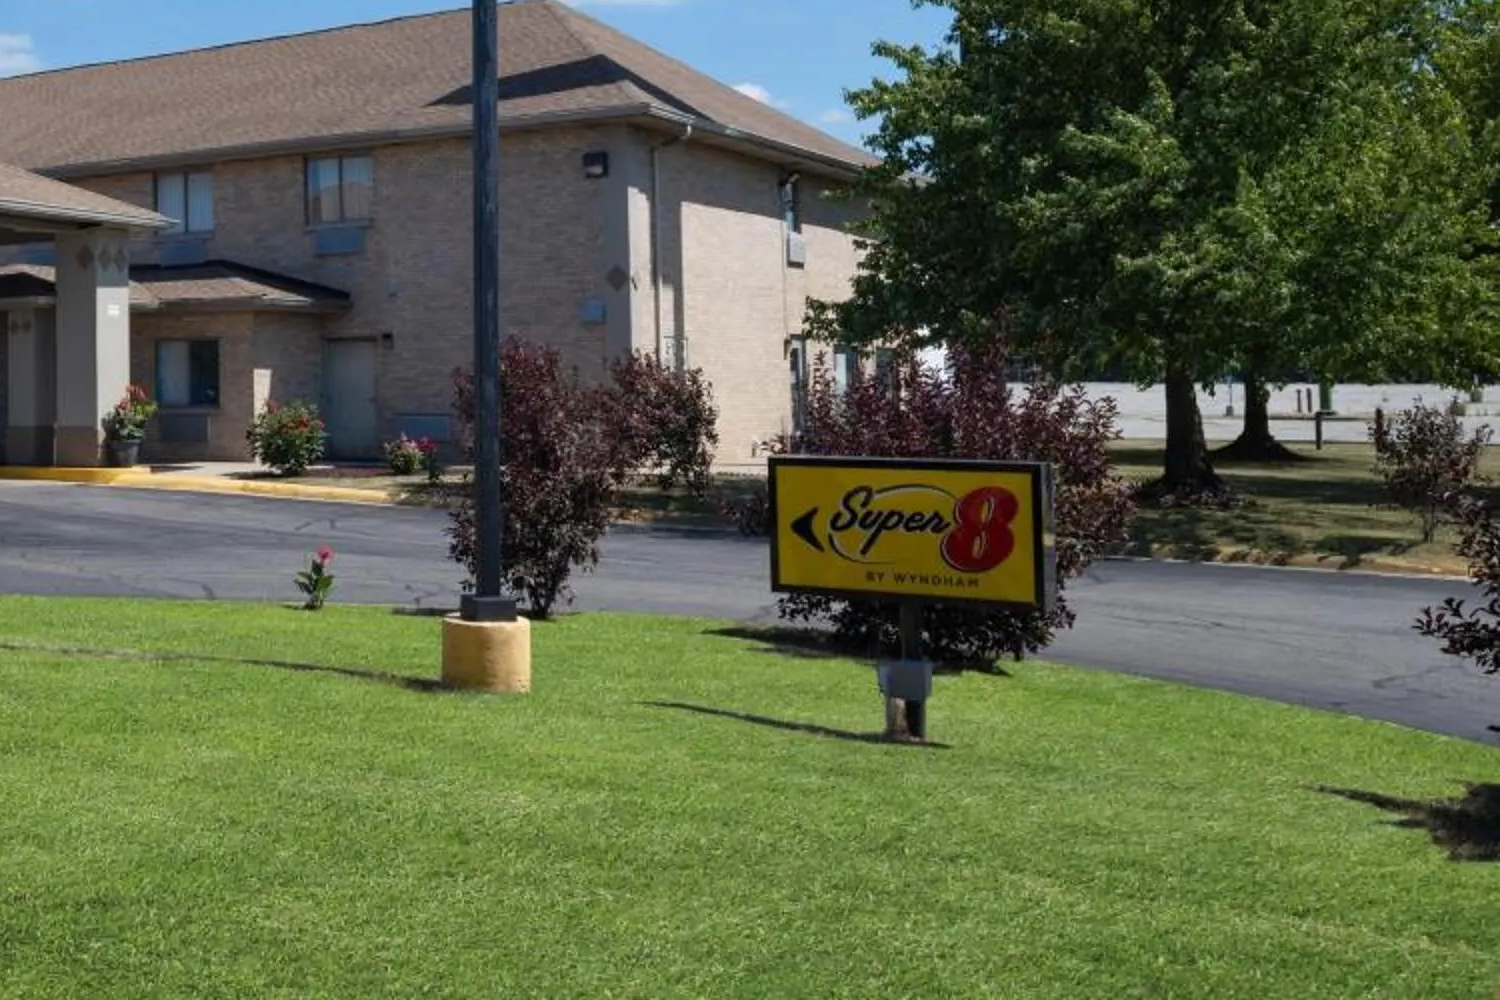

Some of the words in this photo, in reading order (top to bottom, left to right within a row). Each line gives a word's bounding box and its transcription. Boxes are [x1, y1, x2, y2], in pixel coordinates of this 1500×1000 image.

[829, 485, 951, 556] Super
[940, 486, 1019, 573] 8
[866, 571, 885, 582] BY
[894, 572, 980, 588] WYNDHAM
